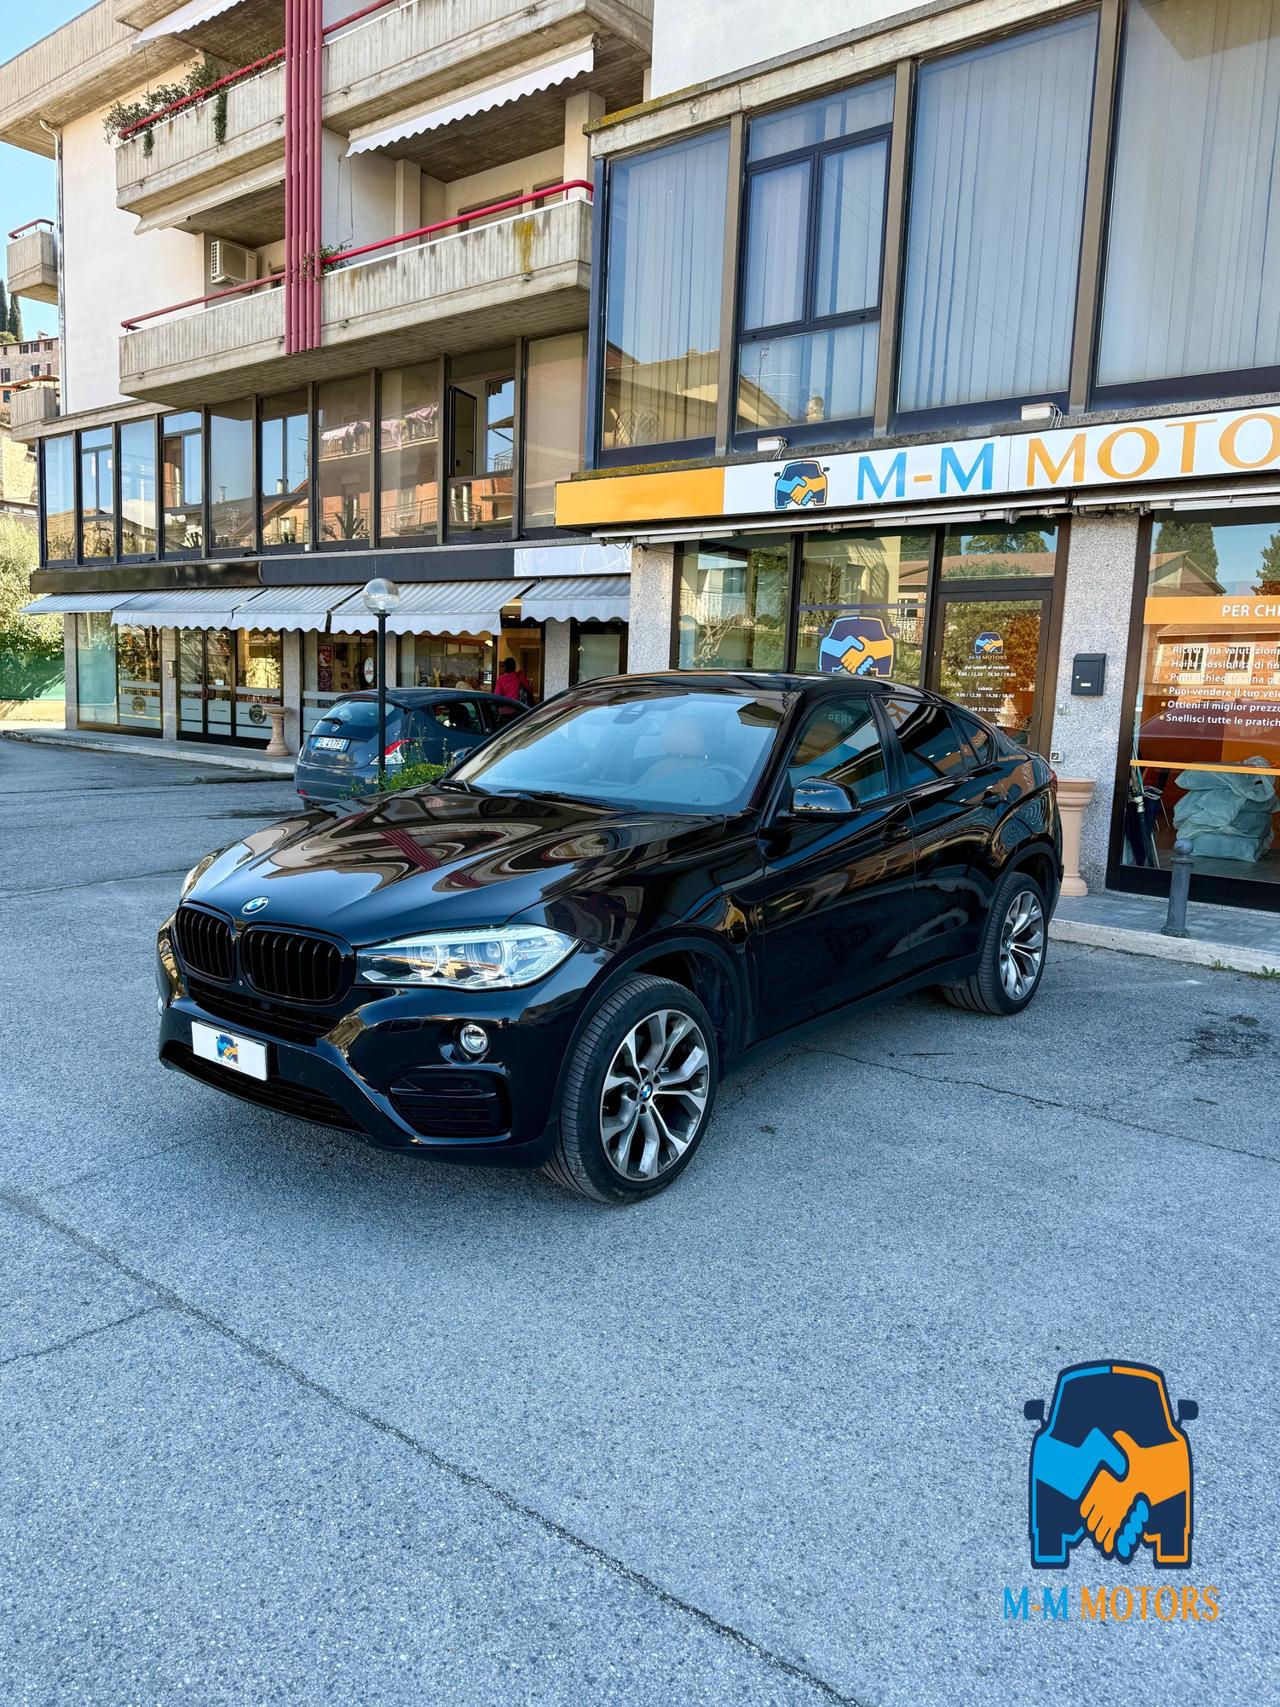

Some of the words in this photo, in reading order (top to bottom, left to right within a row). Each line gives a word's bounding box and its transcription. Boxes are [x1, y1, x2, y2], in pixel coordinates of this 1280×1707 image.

[857, 442, 994, 501] M-M
[1026, 413, 1280, 487] MOTO
[1222, 604, 1249, 617] PER
[1193, 687, 1232, 697] vendere
[1234, 687, 1240, 697] il
[1242, 688, 1260, 698] tuo
[1167, 700, 1201, 709] Ottieni
[1203, 701, 1209, 710] il
[1212, 701, 1247, 713] miglior
[1166, 713, 1205, 723] Snellisci
[1207, 715, 1232, 724] tutte
[1234, 716, 1243, 725] le
